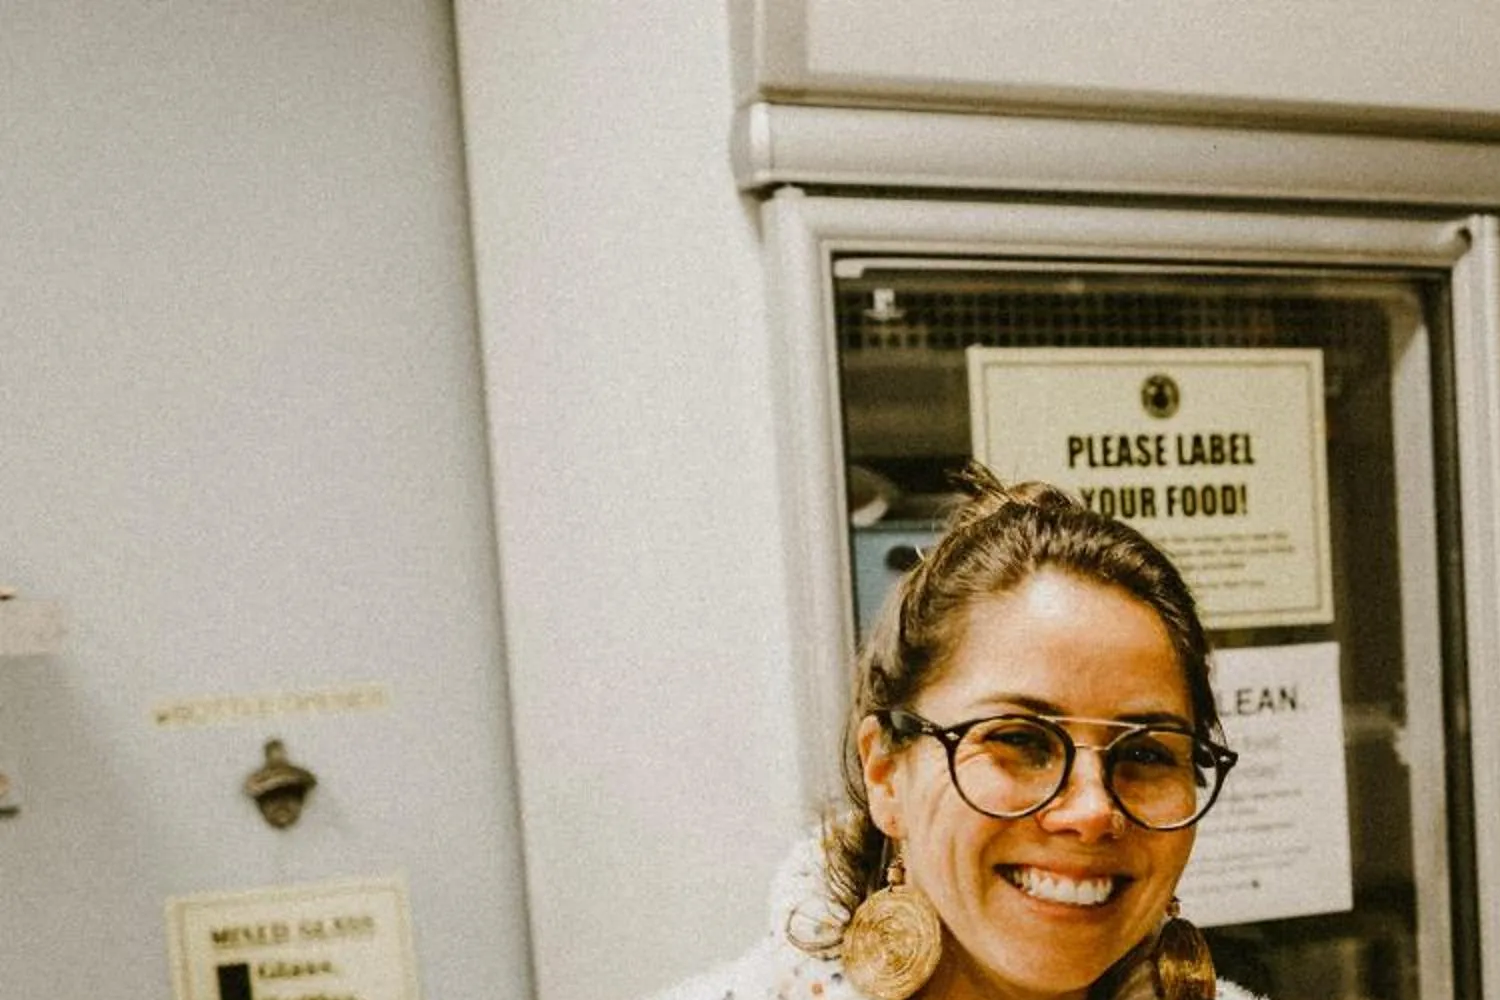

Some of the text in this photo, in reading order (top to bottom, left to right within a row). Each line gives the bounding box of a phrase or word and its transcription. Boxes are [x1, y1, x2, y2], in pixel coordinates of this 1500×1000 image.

[1067, 432, 1256, 469] PLEASE LABEL
[1081, 484, 1248, 519] YOUR FOOD!
[1214, 685, 1298, 717] LEAN
